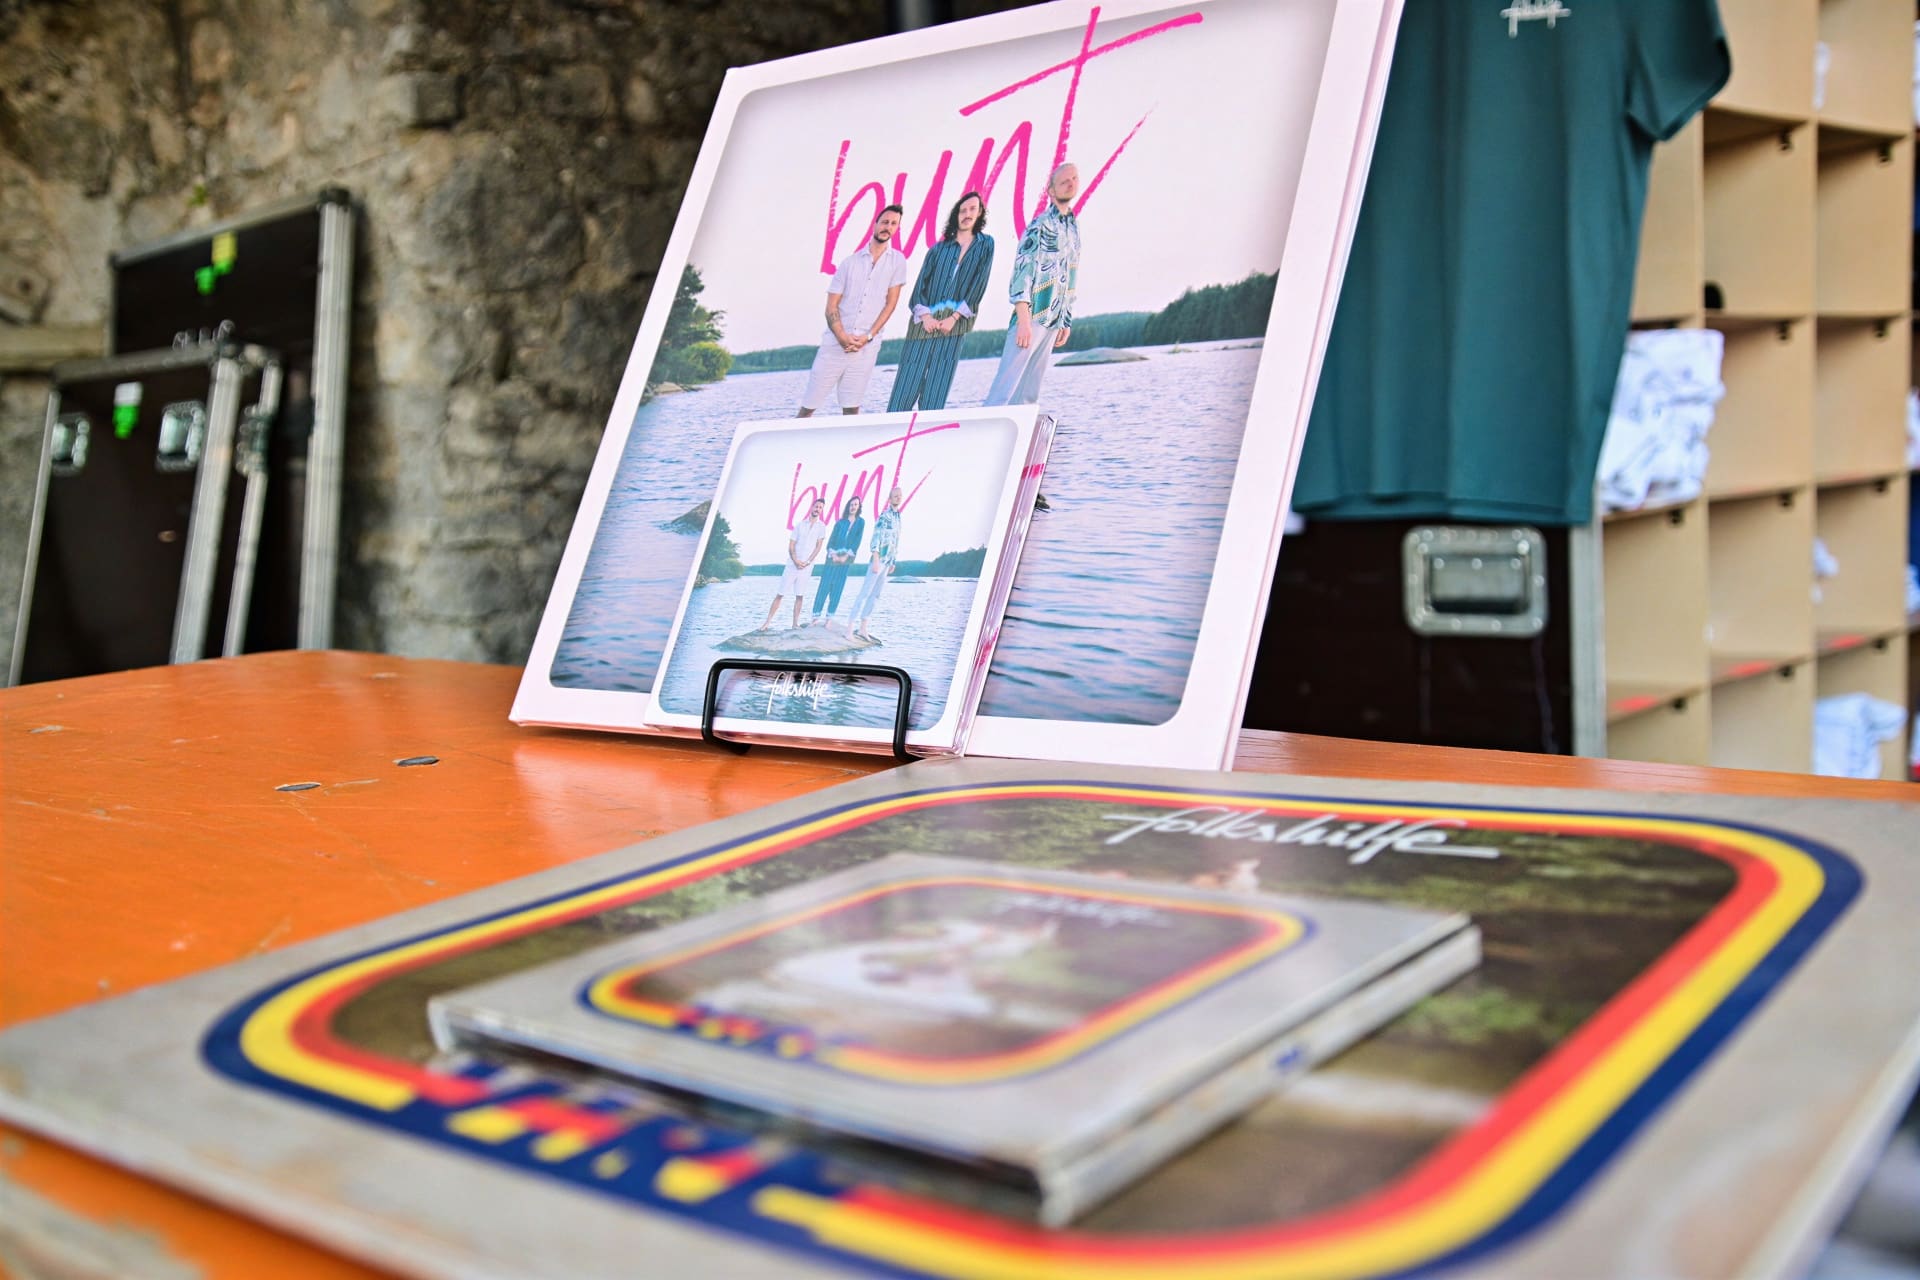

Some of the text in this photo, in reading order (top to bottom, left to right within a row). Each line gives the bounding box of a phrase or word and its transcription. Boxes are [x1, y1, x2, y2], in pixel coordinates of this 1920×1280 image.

[820, 6, 1203, 275] bunt
[787, 413, 960, 531] bunt
[762, 671, 838, 714] folkshilfe
[1102, 806, 1500, 865] folkshilfe
